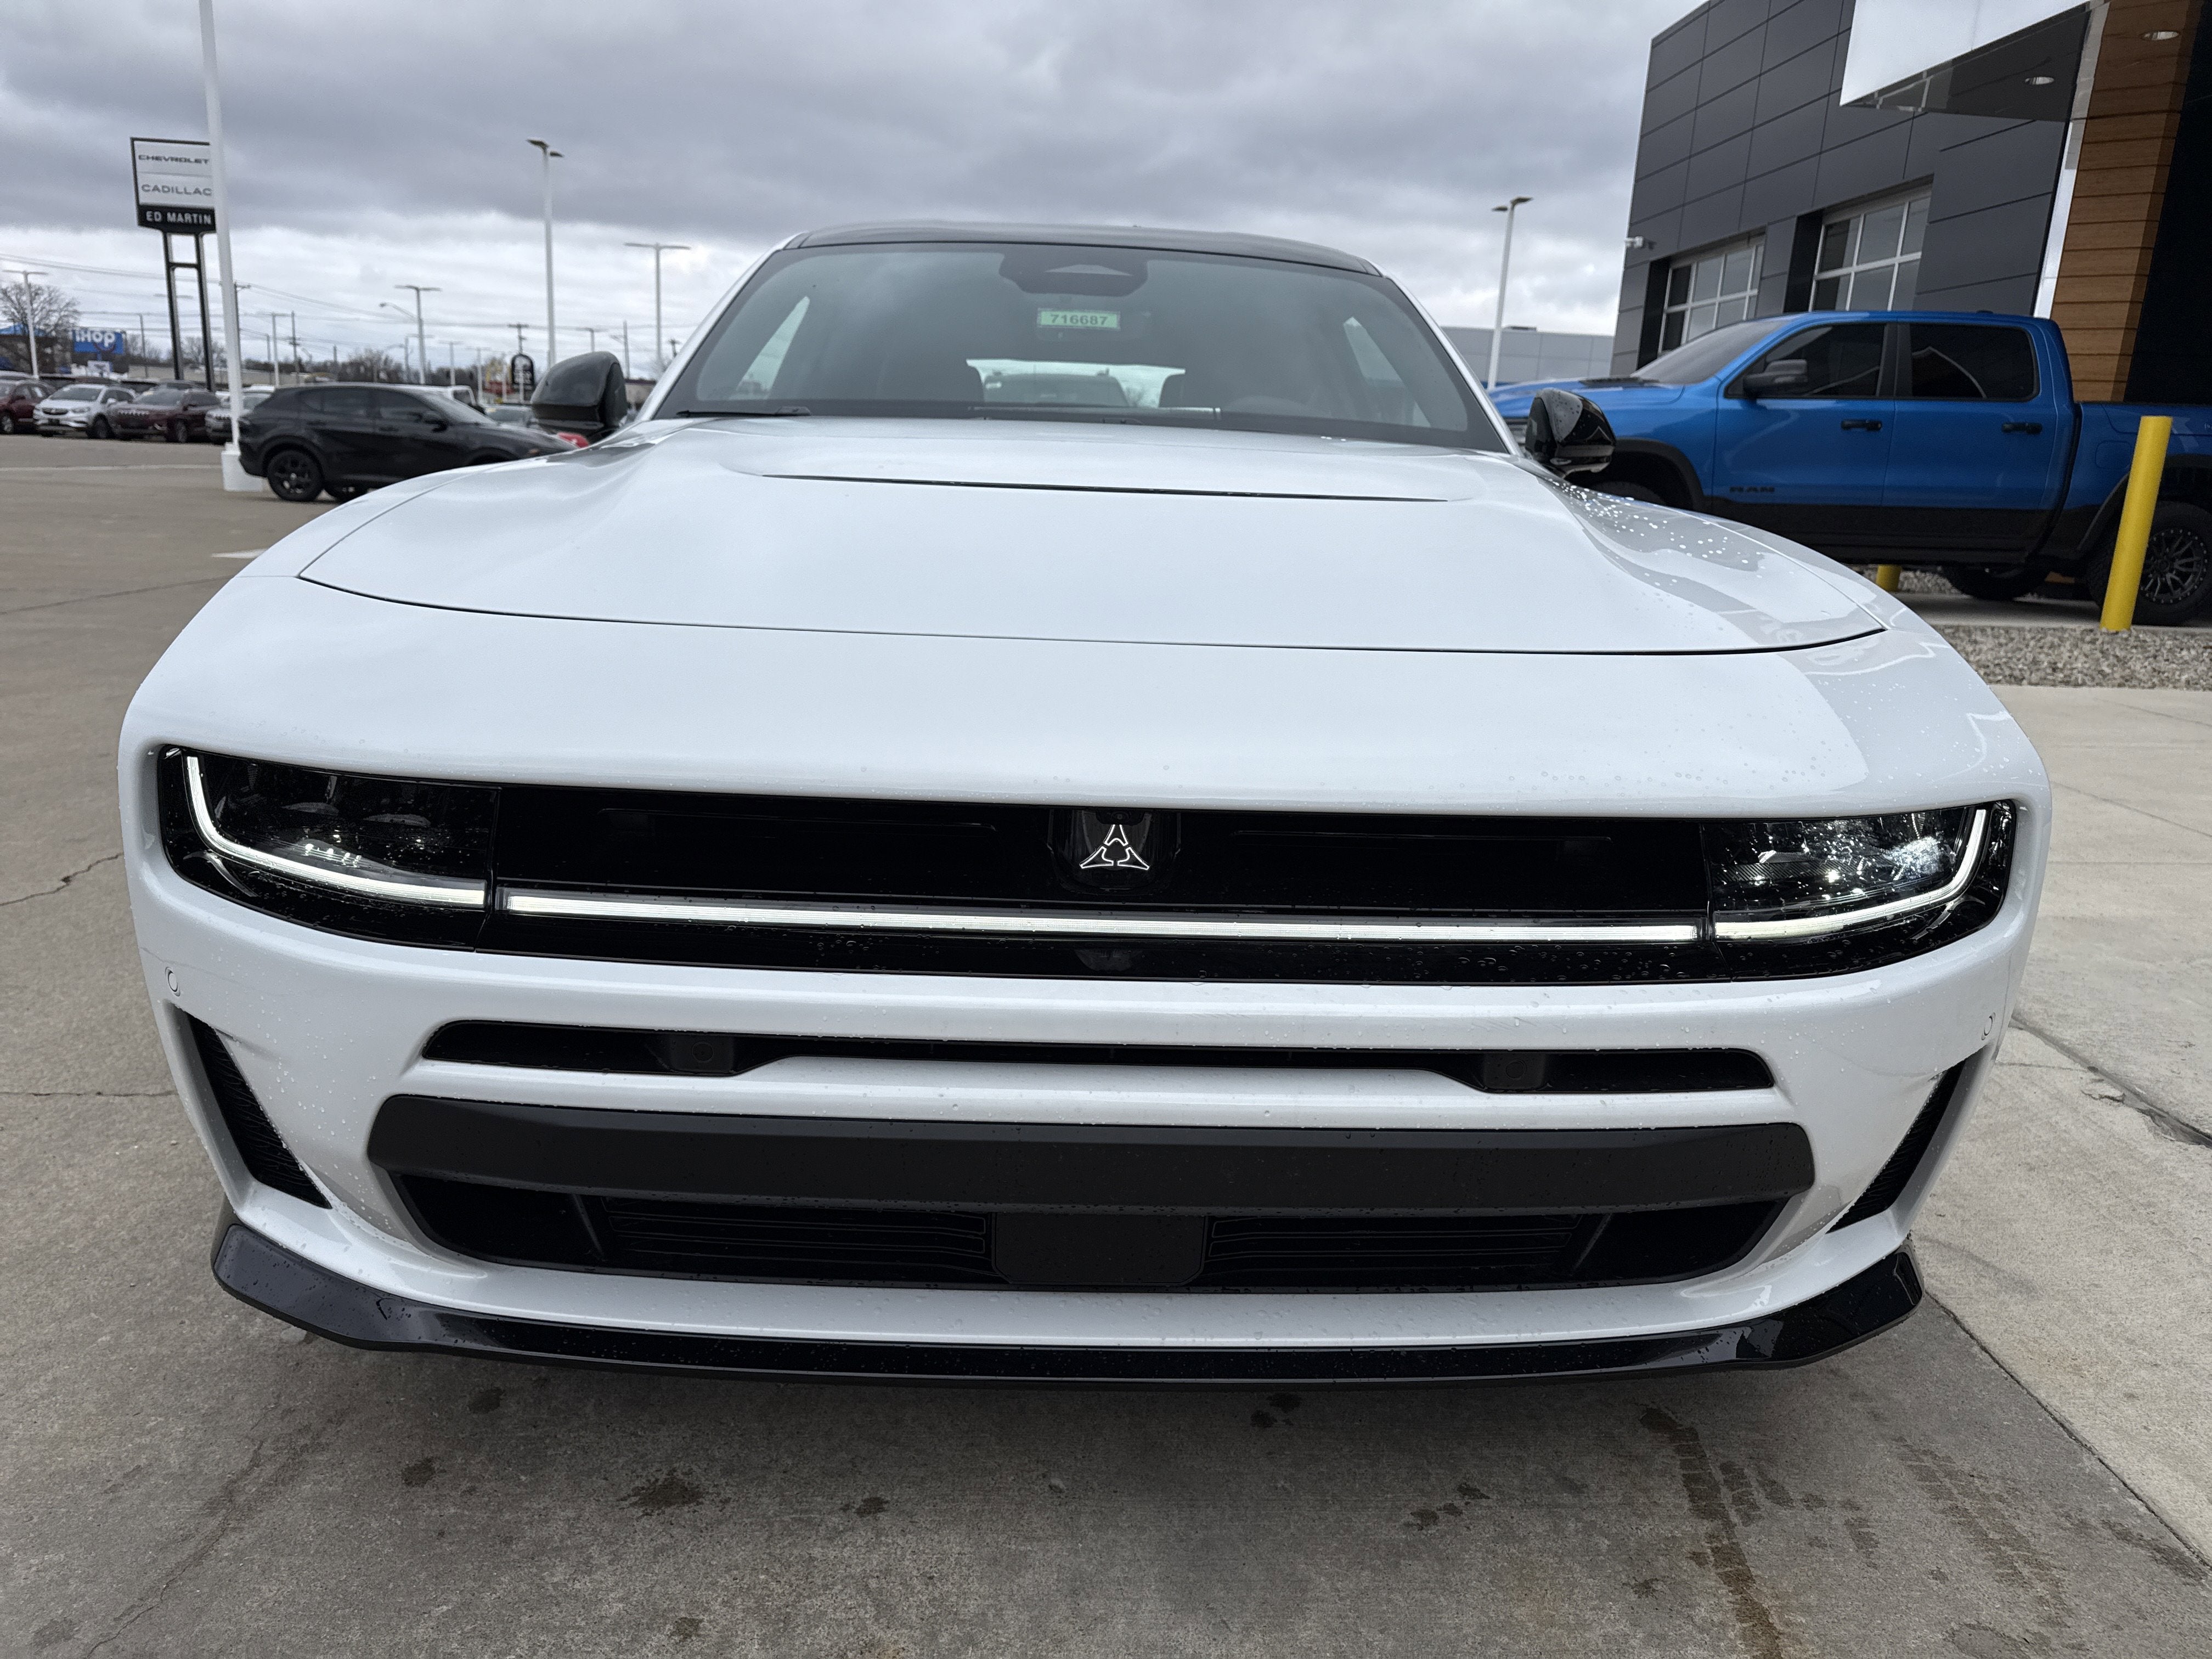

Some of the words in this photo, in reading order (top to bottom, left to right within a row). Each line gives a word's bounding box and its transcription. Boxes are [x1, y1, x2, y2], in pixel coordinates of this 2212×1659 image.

[138, 154, 209, 164] CHEVROLET
[141, 184, 212, 196] CADILLAC
[146, 211, 162, 222] ED
[166, 212, 212, 224] MARTIN
[1050, 314, 1108, 325] 716687
